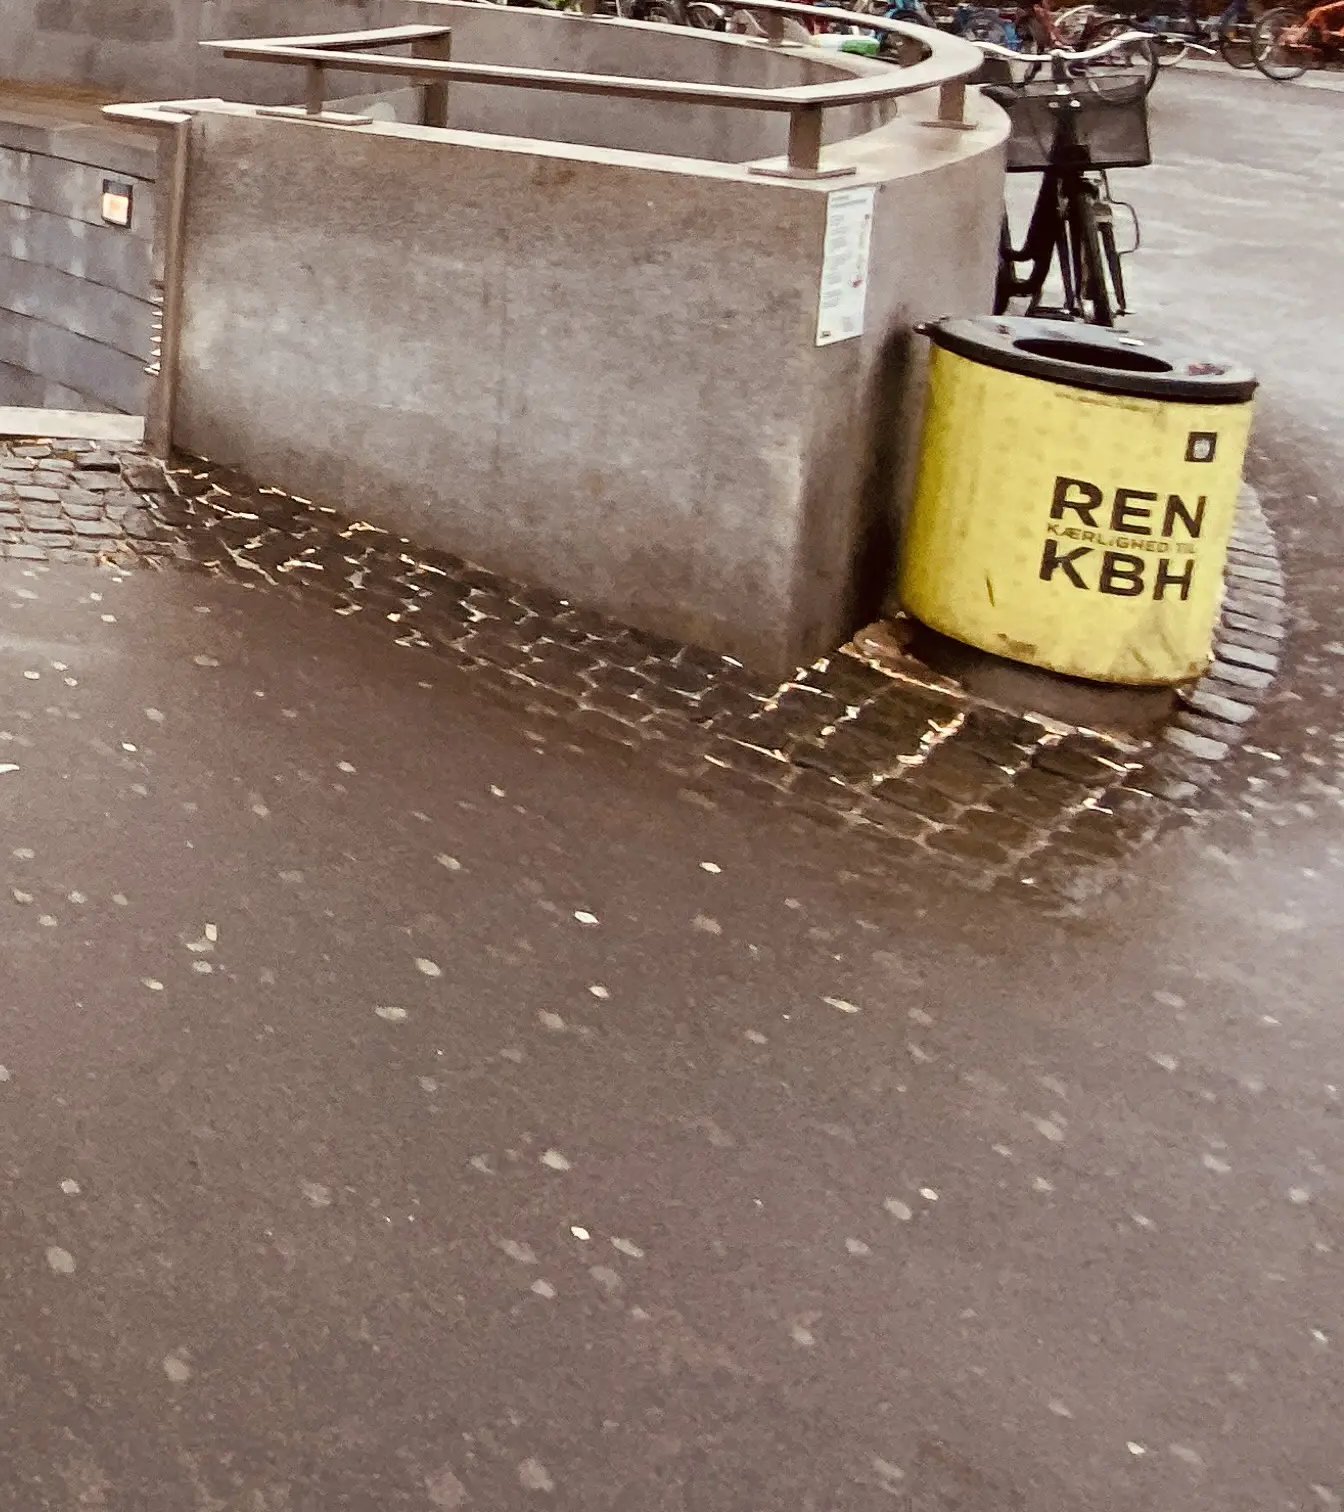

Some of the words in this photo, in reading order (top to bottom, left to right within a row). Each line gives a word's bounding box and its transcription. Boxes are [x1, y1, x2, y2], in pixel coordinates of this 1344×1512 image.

[1046, 522, 1169, 553] KÆRLIGHED
[1049, 476, 1207, 538] REN
[1039, 538, 1195, 601] KBH
